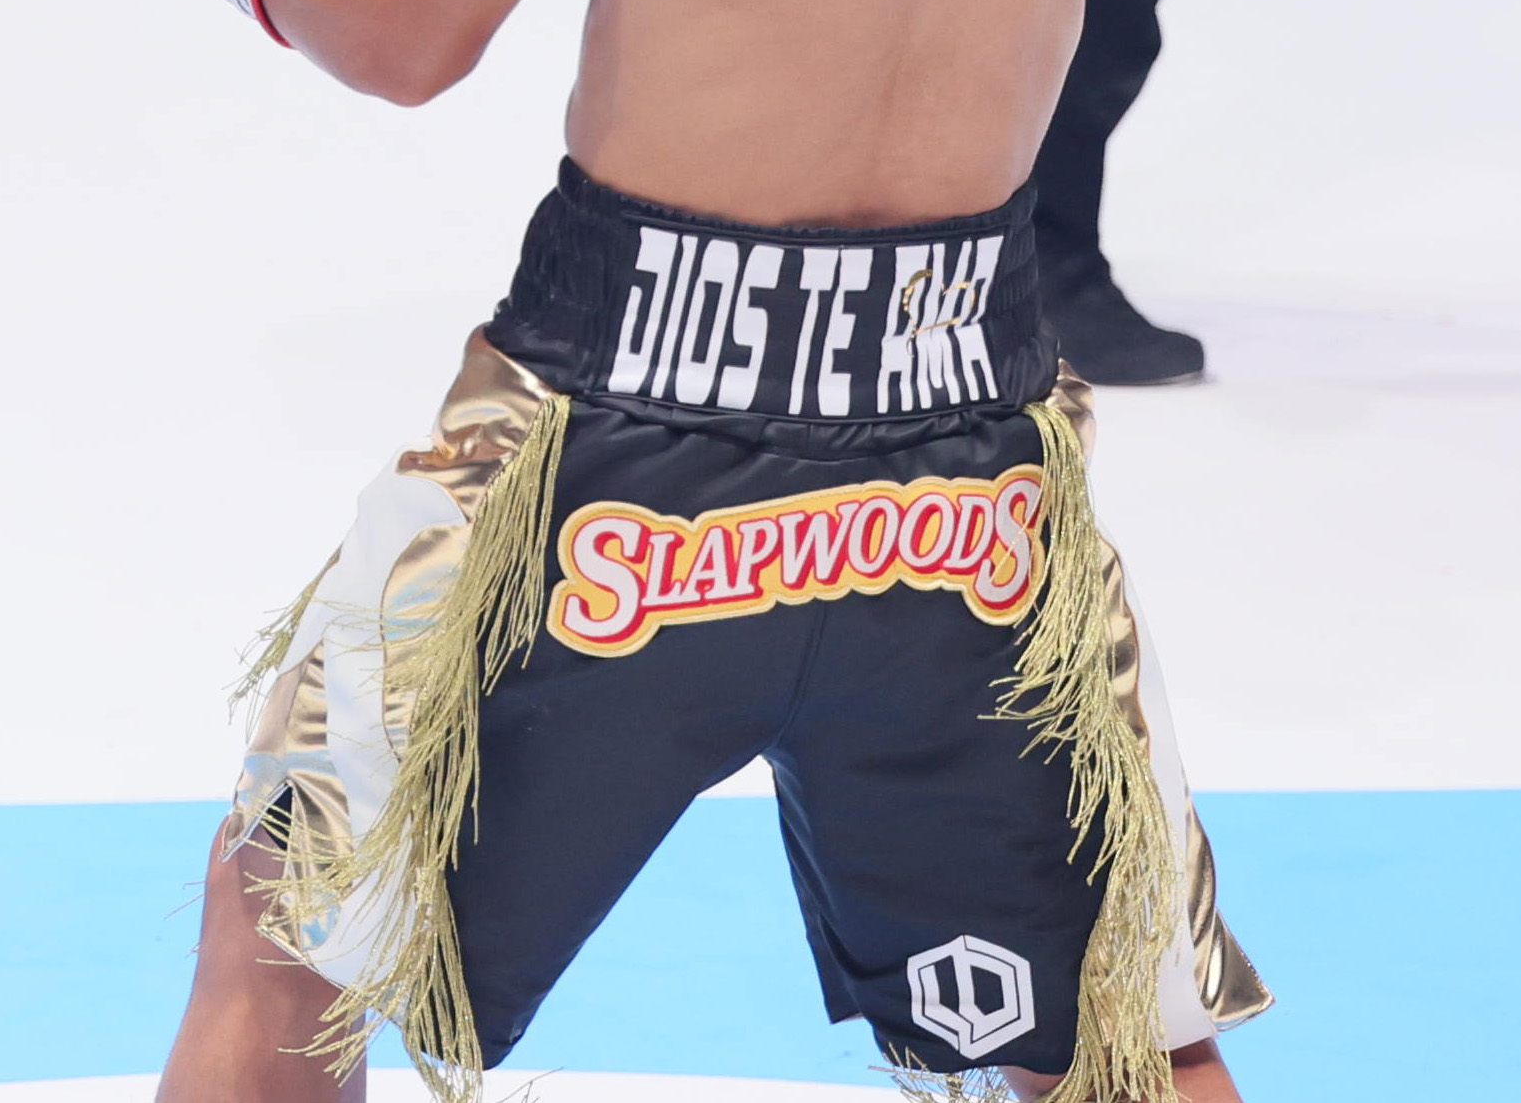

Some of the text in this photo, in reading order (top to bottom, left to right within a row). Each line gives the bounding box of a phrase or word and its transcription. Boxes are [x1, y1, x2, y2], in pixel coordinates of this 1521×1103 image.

[608, 226, 1004, 416] DIOS TE AMA
[562, 475, 1045, 645] SLAPWOODS
